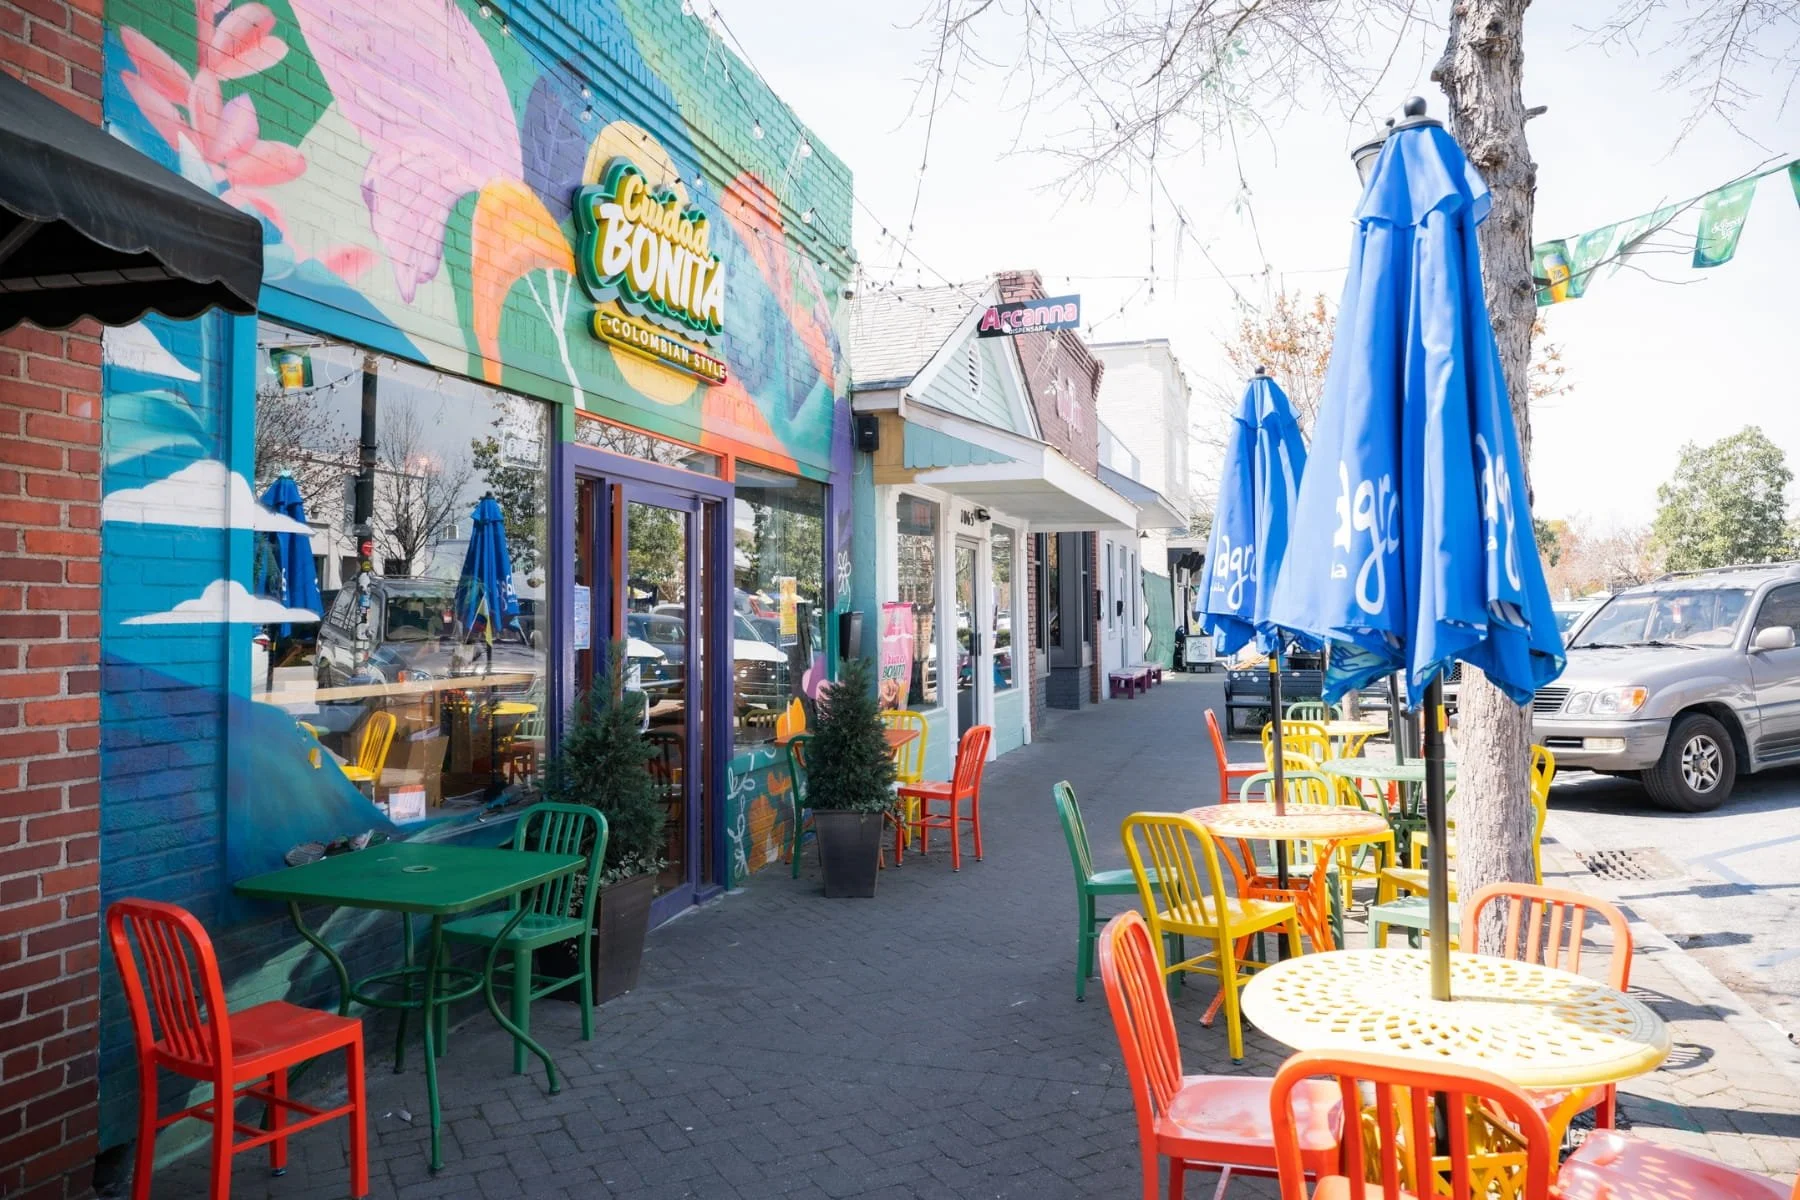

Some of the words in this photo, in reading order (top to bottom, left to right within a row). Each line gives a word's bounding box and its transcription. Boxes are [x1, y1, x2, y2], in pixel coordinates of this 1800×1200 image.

[623, 174, 711, 259] Ciudad
[600, 202, 725, 325] BONITA
[611, 317, 690, 364] COLOMBIAN
[693, 353, 727, 378] STYLE
[980, 304, 1078, 331] Arcanna
[1008, 325, 1048, 335] DISPENSARY
